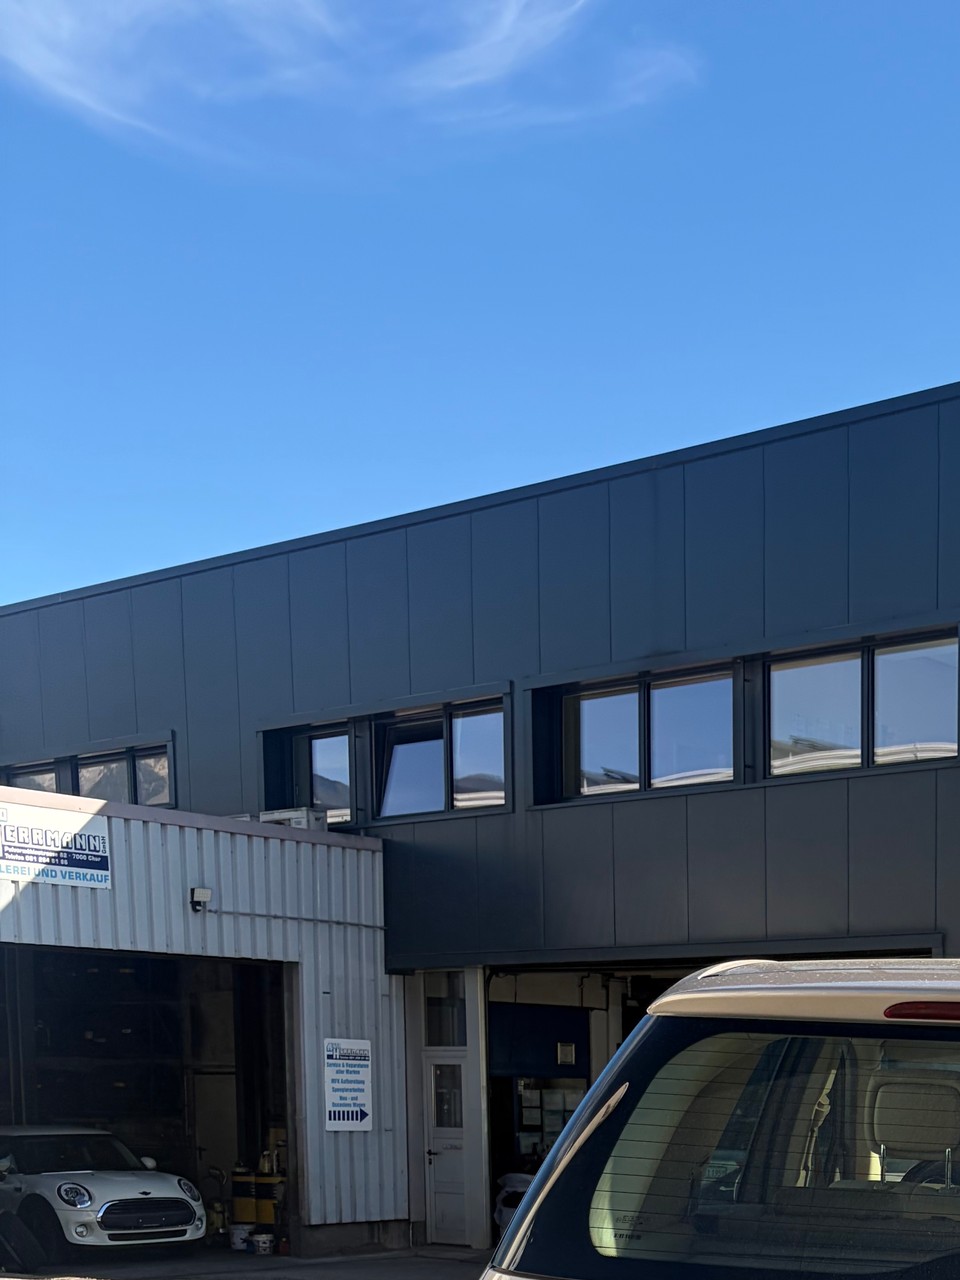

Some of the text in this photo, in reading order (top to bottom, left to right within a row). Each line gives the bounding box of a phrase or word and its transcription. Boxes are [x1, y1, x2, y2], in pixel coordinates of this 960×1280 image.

[0, 824, 100, 853] ERRMANN
[34, 867, 57, 878] UND
[60, 870, 110, 883] VERKAUF
